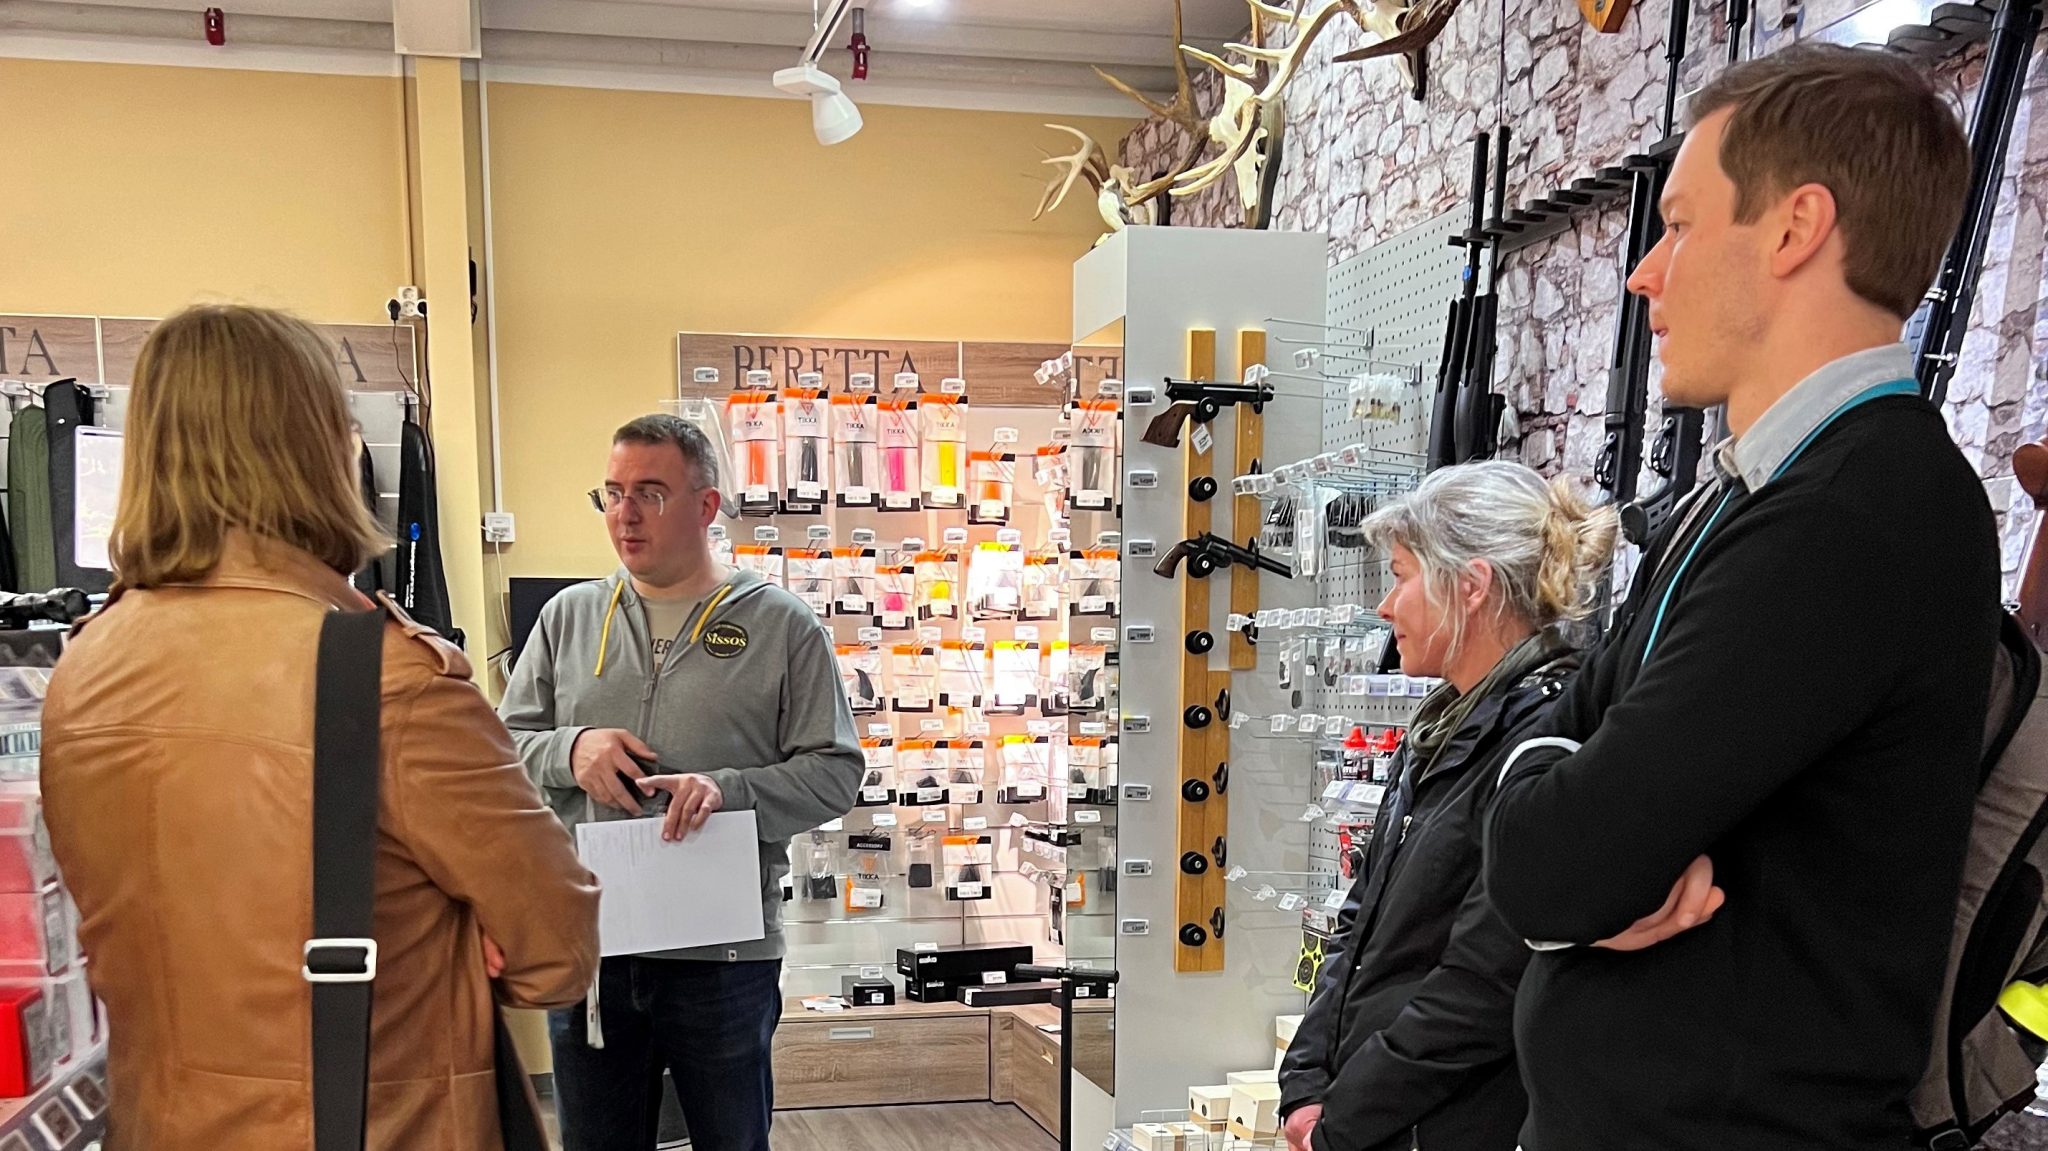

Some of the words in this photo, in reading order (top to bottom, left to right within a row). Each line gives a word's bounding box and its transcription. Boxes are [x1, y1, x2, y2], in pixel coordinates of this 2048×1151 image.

[733, 344, 927, 394] BERETTA
[798, 416, 818, 424] TIKKA
[845, 422, 865, 430] TIKKA
[935, 421, 955, 429] TIKKA
